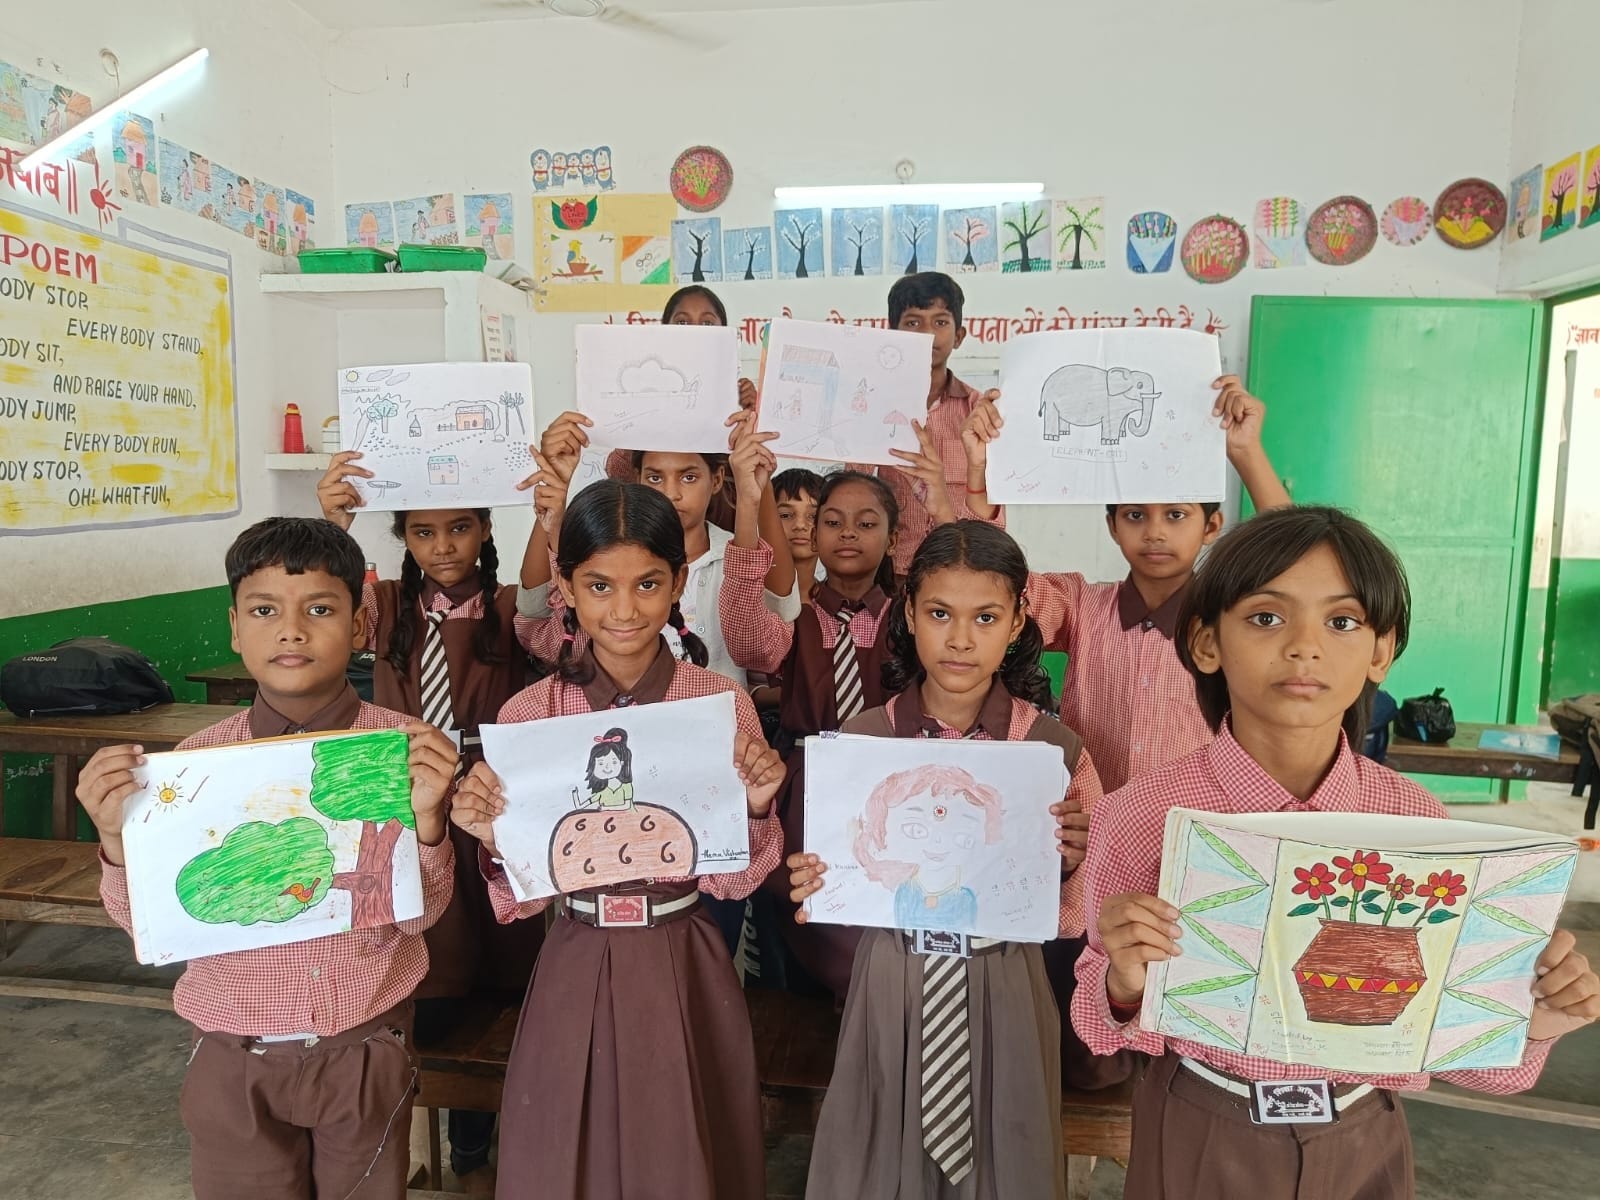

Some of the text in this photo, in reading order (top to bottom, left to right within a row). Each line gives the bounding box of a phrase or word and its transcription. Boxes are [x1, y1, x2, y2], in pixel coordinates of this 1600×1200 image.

[0, 234, 98, 285] POEM
[35, 343, 64, 367] SIT,
[53, 374, 82, 395] AND
[85, 376, 123, 400] RAISE
[128, 381, 159, 403] YOUR
[32, 399, 77, 425] JUMP,
[152, 436, 181, 461] RUN,
[33, 460, 82, 483] STOP,
[68, 485, 171, 508] OH! WHAT FUN,
[22, 655, 58, 663] LONDON
